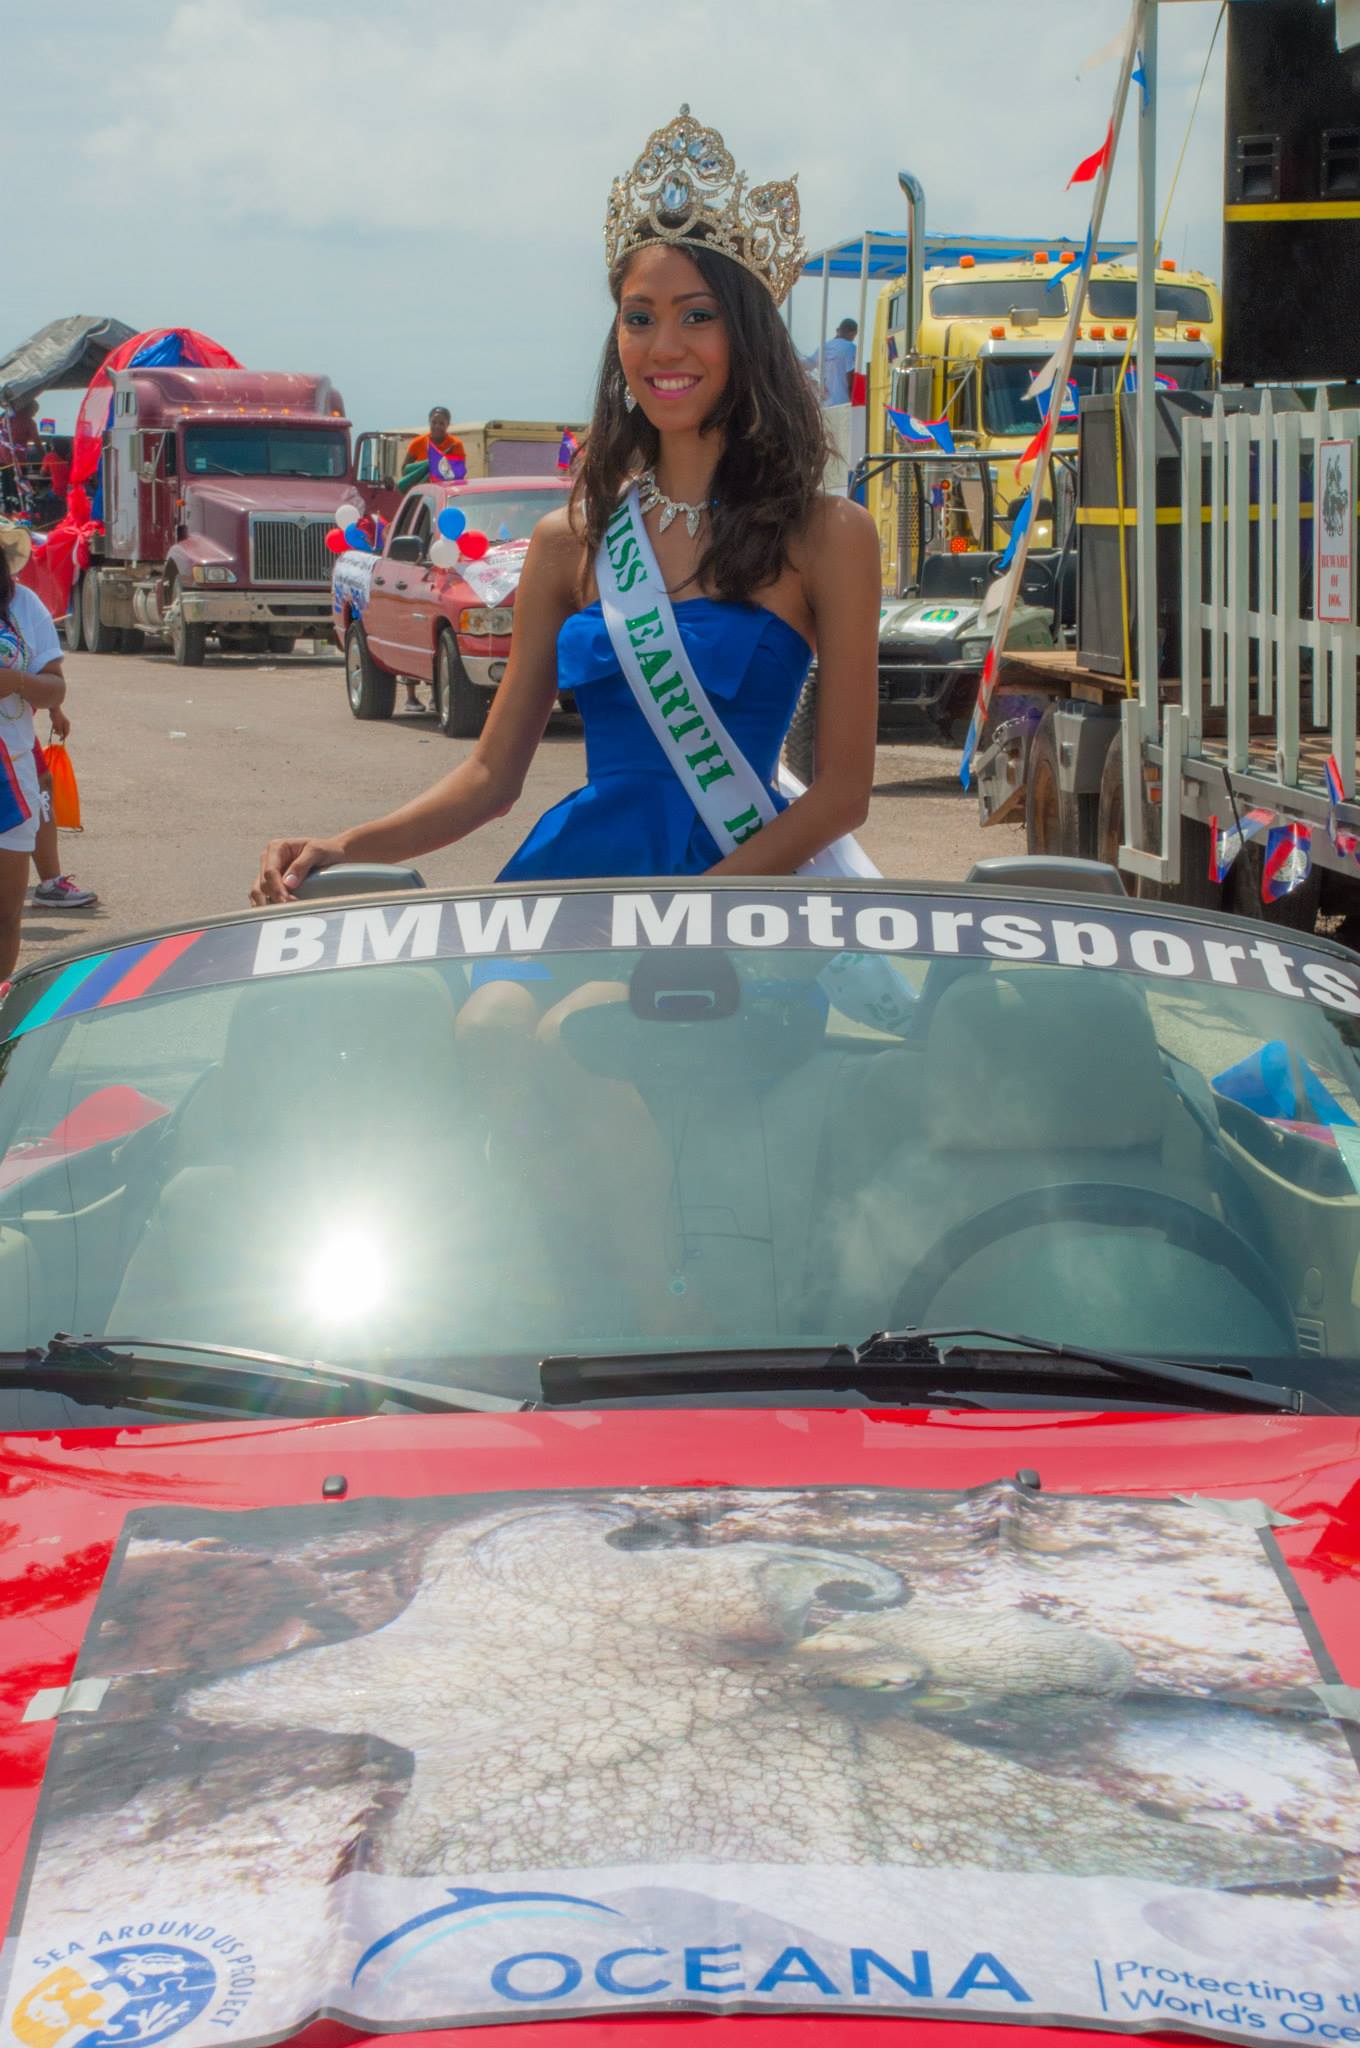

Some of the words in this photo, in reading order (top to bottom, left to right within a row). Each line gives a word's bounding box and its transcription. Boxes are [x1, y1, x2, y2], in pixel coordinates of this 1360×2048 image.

[624, 605, 735, 793] EARTH
[252, 897, 562, 975] BMW
[612, 893, 1360, 1016] Motorsports
[32, 1941, 85, 1969] SEA
[96, 1921, 216, 1945] AROUND
[212, 1934, 244, 1955] US
[209, 1954, 257, 2028] PROJECT
[490, 1943, 1034, 2002] OCEANA
[1115, 1960, 1325, 2012] Protecting
[1120, 1988, 1267, 2029] World's
